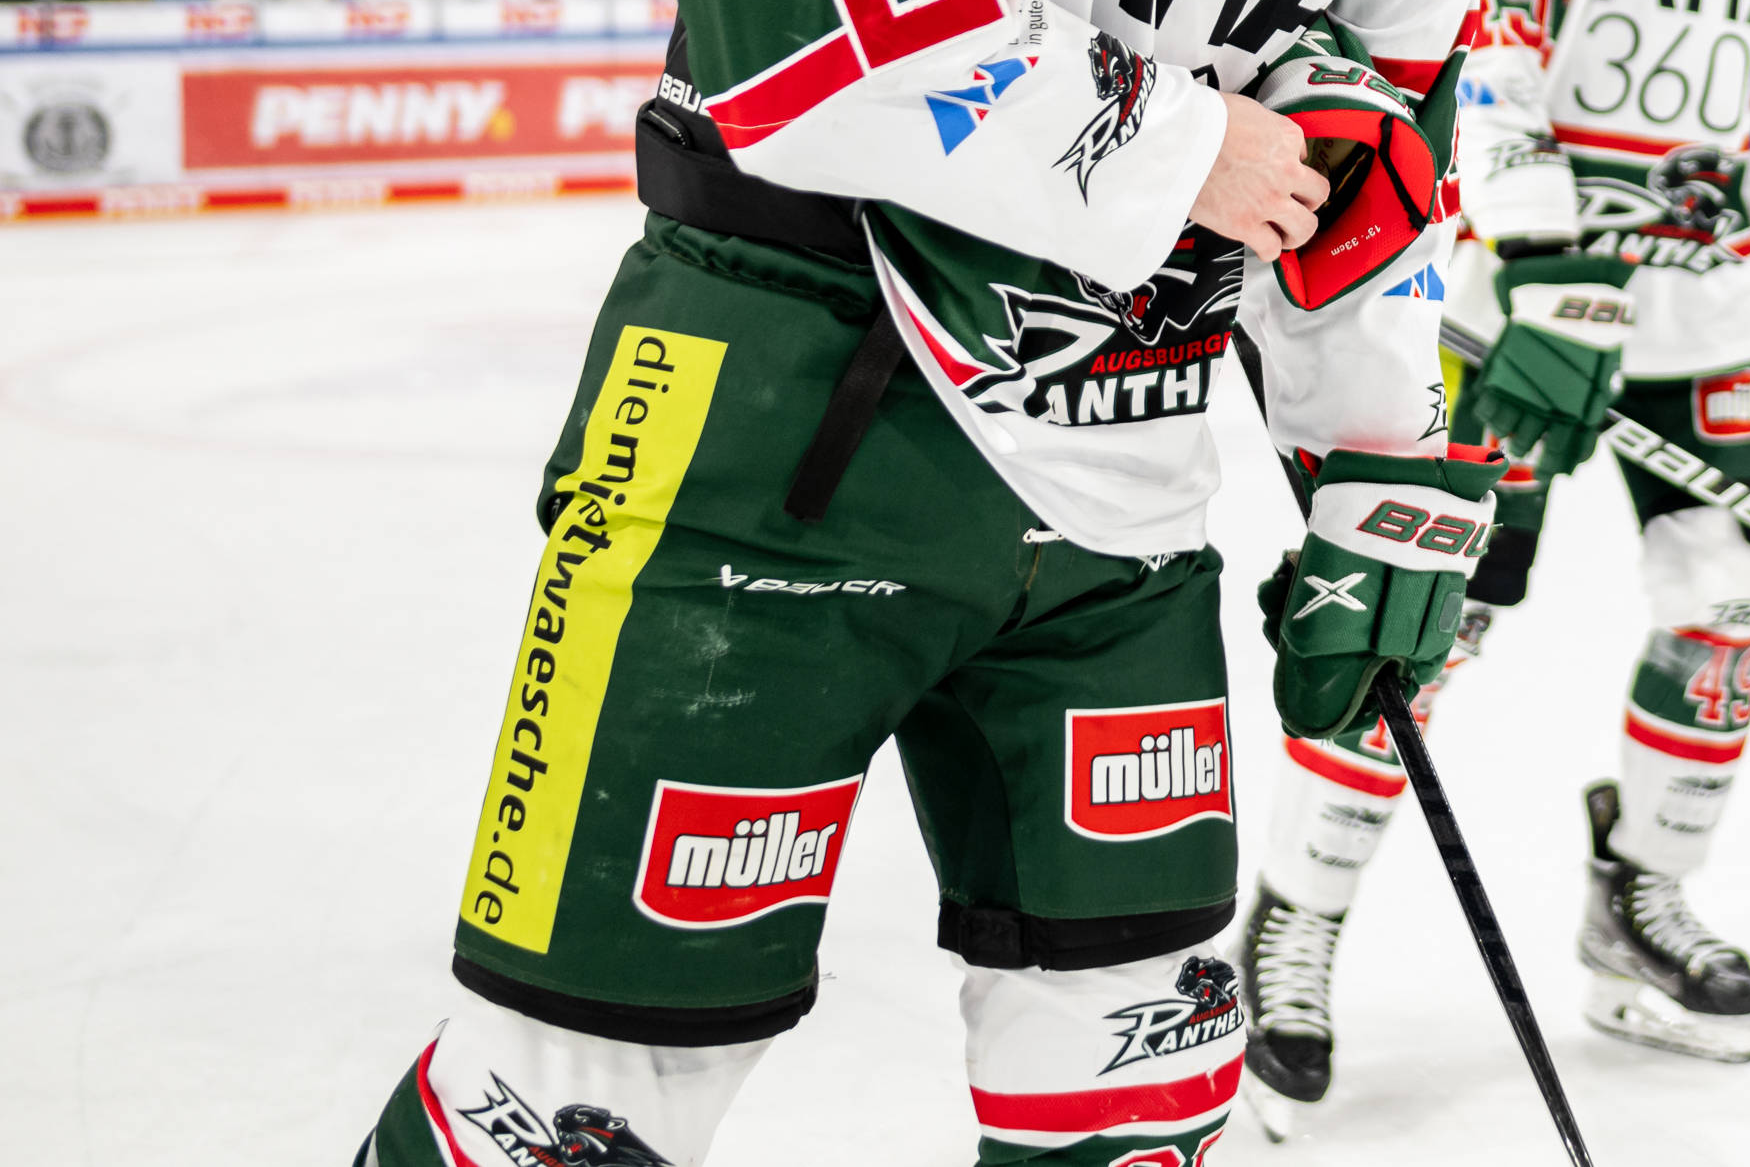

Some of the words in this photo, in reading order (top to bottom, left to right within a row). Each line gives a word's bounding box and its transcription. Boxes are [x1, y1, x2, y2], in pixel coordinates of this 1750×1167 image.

[1090, 331, 1232, 375] AUGSBURG
[1089, 725, 1224, 807] müller
[665, 810, 840, 890] müller
